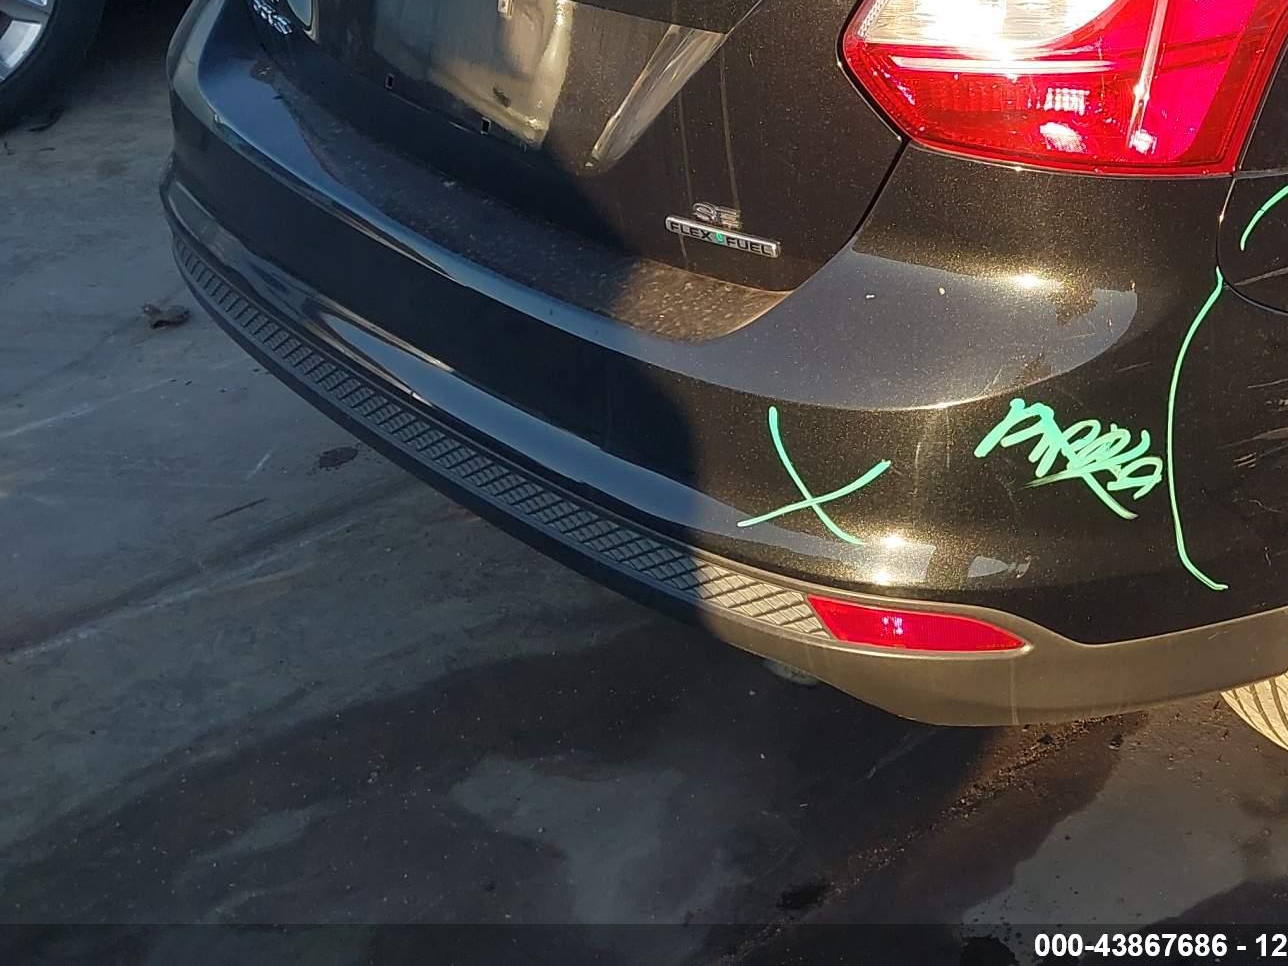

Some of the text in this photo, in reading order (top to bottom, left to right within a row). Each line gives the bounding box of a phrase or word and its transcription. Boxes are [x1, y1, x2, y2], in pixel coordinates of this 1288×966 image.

[692, 202, 741, 229] SE
[670, 221, 775, 256] FLEX FUEL
